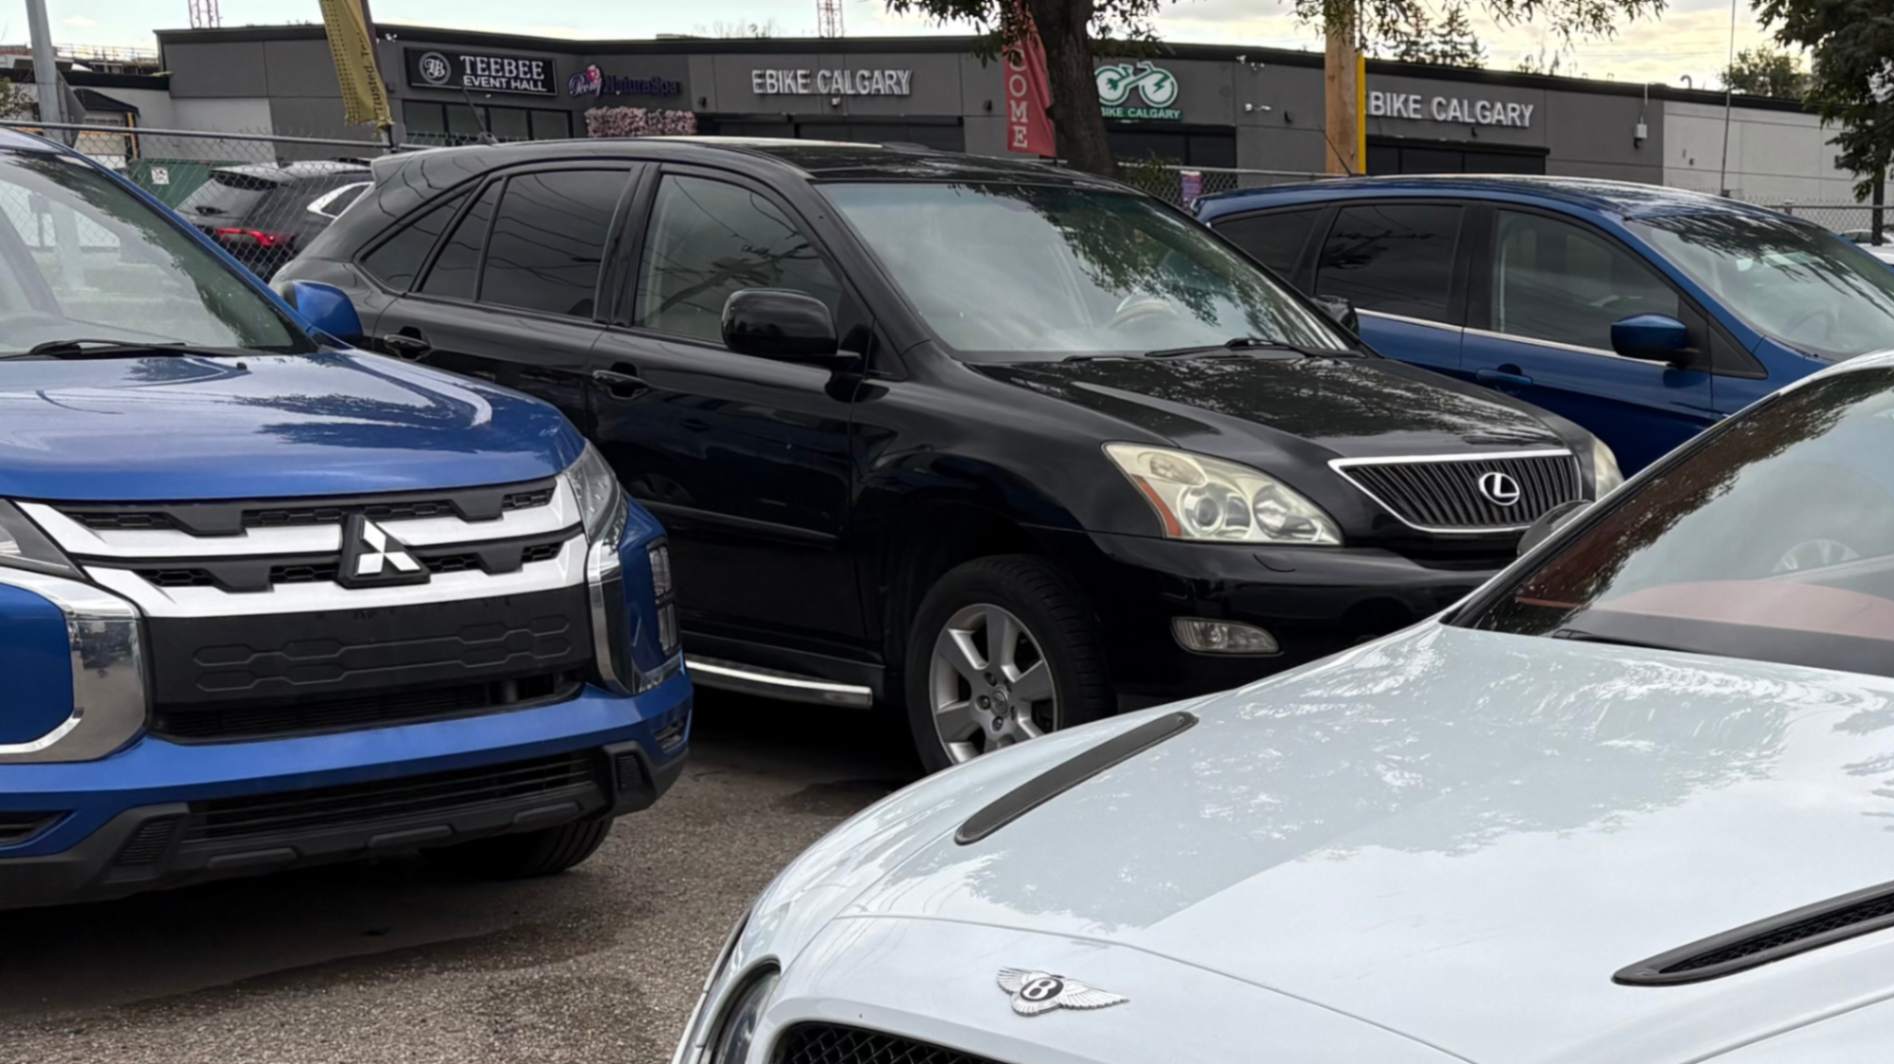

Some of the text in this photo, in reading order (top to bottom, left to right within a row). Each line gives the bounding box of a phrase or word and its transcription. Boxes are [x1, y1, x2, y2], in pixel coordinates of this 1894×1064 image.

[460, 55, 545, 80] TEEBEE
[463, 75, 547, 92] EVENT HALL
[751, 69, 911, 96] EBIKE CALGARY
[1008, 47, 1029, 148] COME
[1368, 90, 1534, 128] BIKE CALGARY
[1127, 107, 1181, 119] CALGARY
